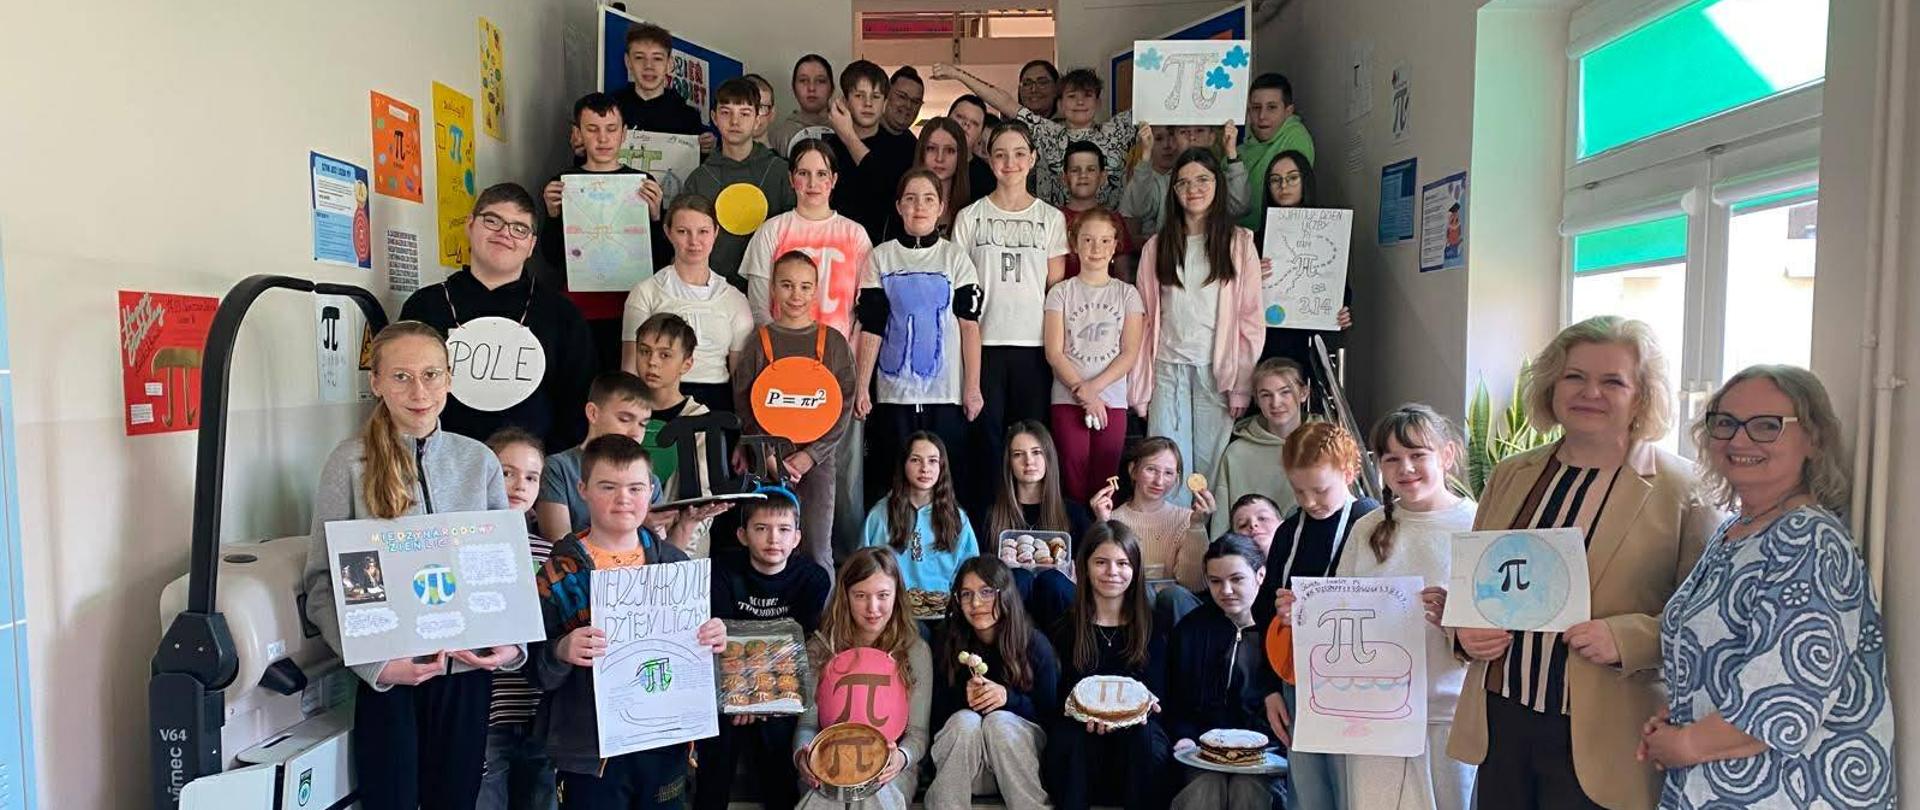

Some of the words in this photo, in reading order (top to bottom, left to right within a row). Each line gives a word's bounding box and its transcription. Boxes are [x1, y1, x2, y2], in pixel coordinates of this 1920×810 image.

[976, 218, 1046, 251] LICZBA
[1001, 252, 1022, 282] PI
[449, 340, 536, 381] POLE
[767, 391, 780, 405] P
[159, 729, 187, 742] V64
